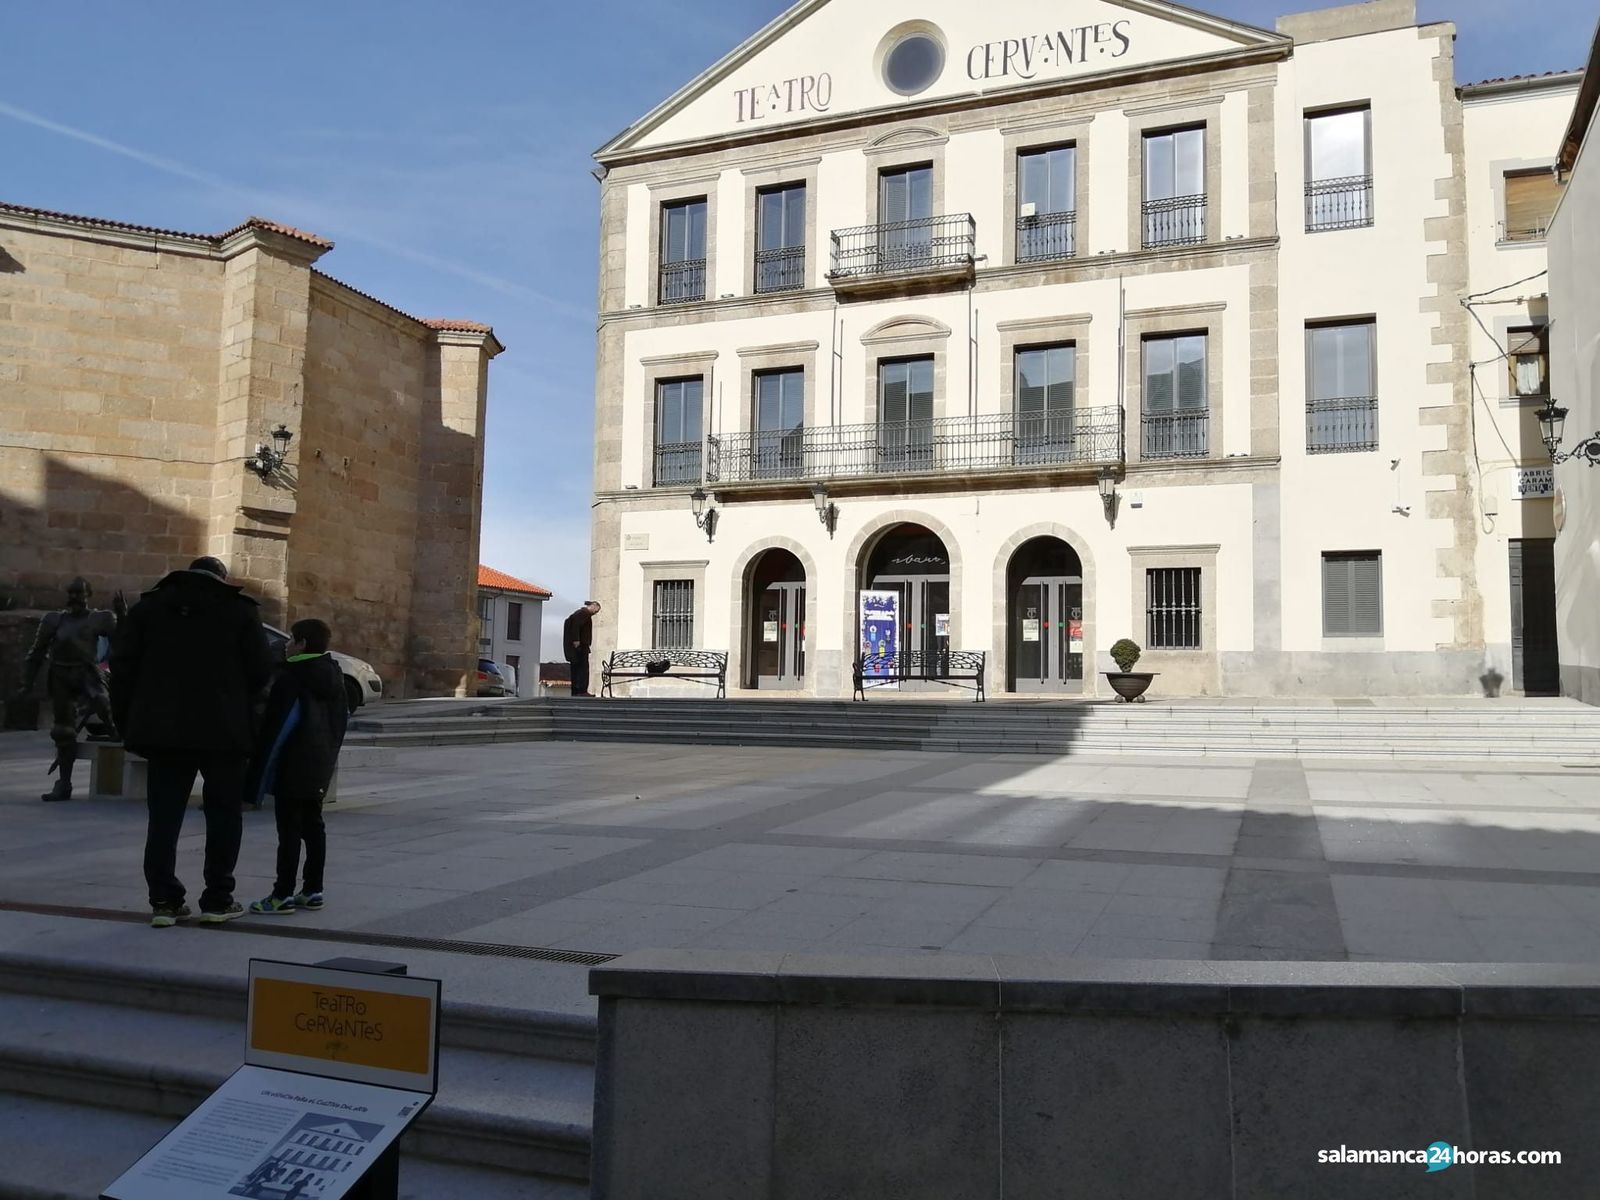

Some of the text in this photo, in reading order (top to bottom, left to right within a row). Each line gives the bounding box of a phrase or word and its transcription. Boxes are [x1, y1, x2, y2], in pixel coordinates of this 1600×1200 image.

[733, 20, 1131, 123] TEATRO CERVANTES
[1518, 469, 1553, 477] FABRIC
[1519, 477, 1554, 485] CARAM
